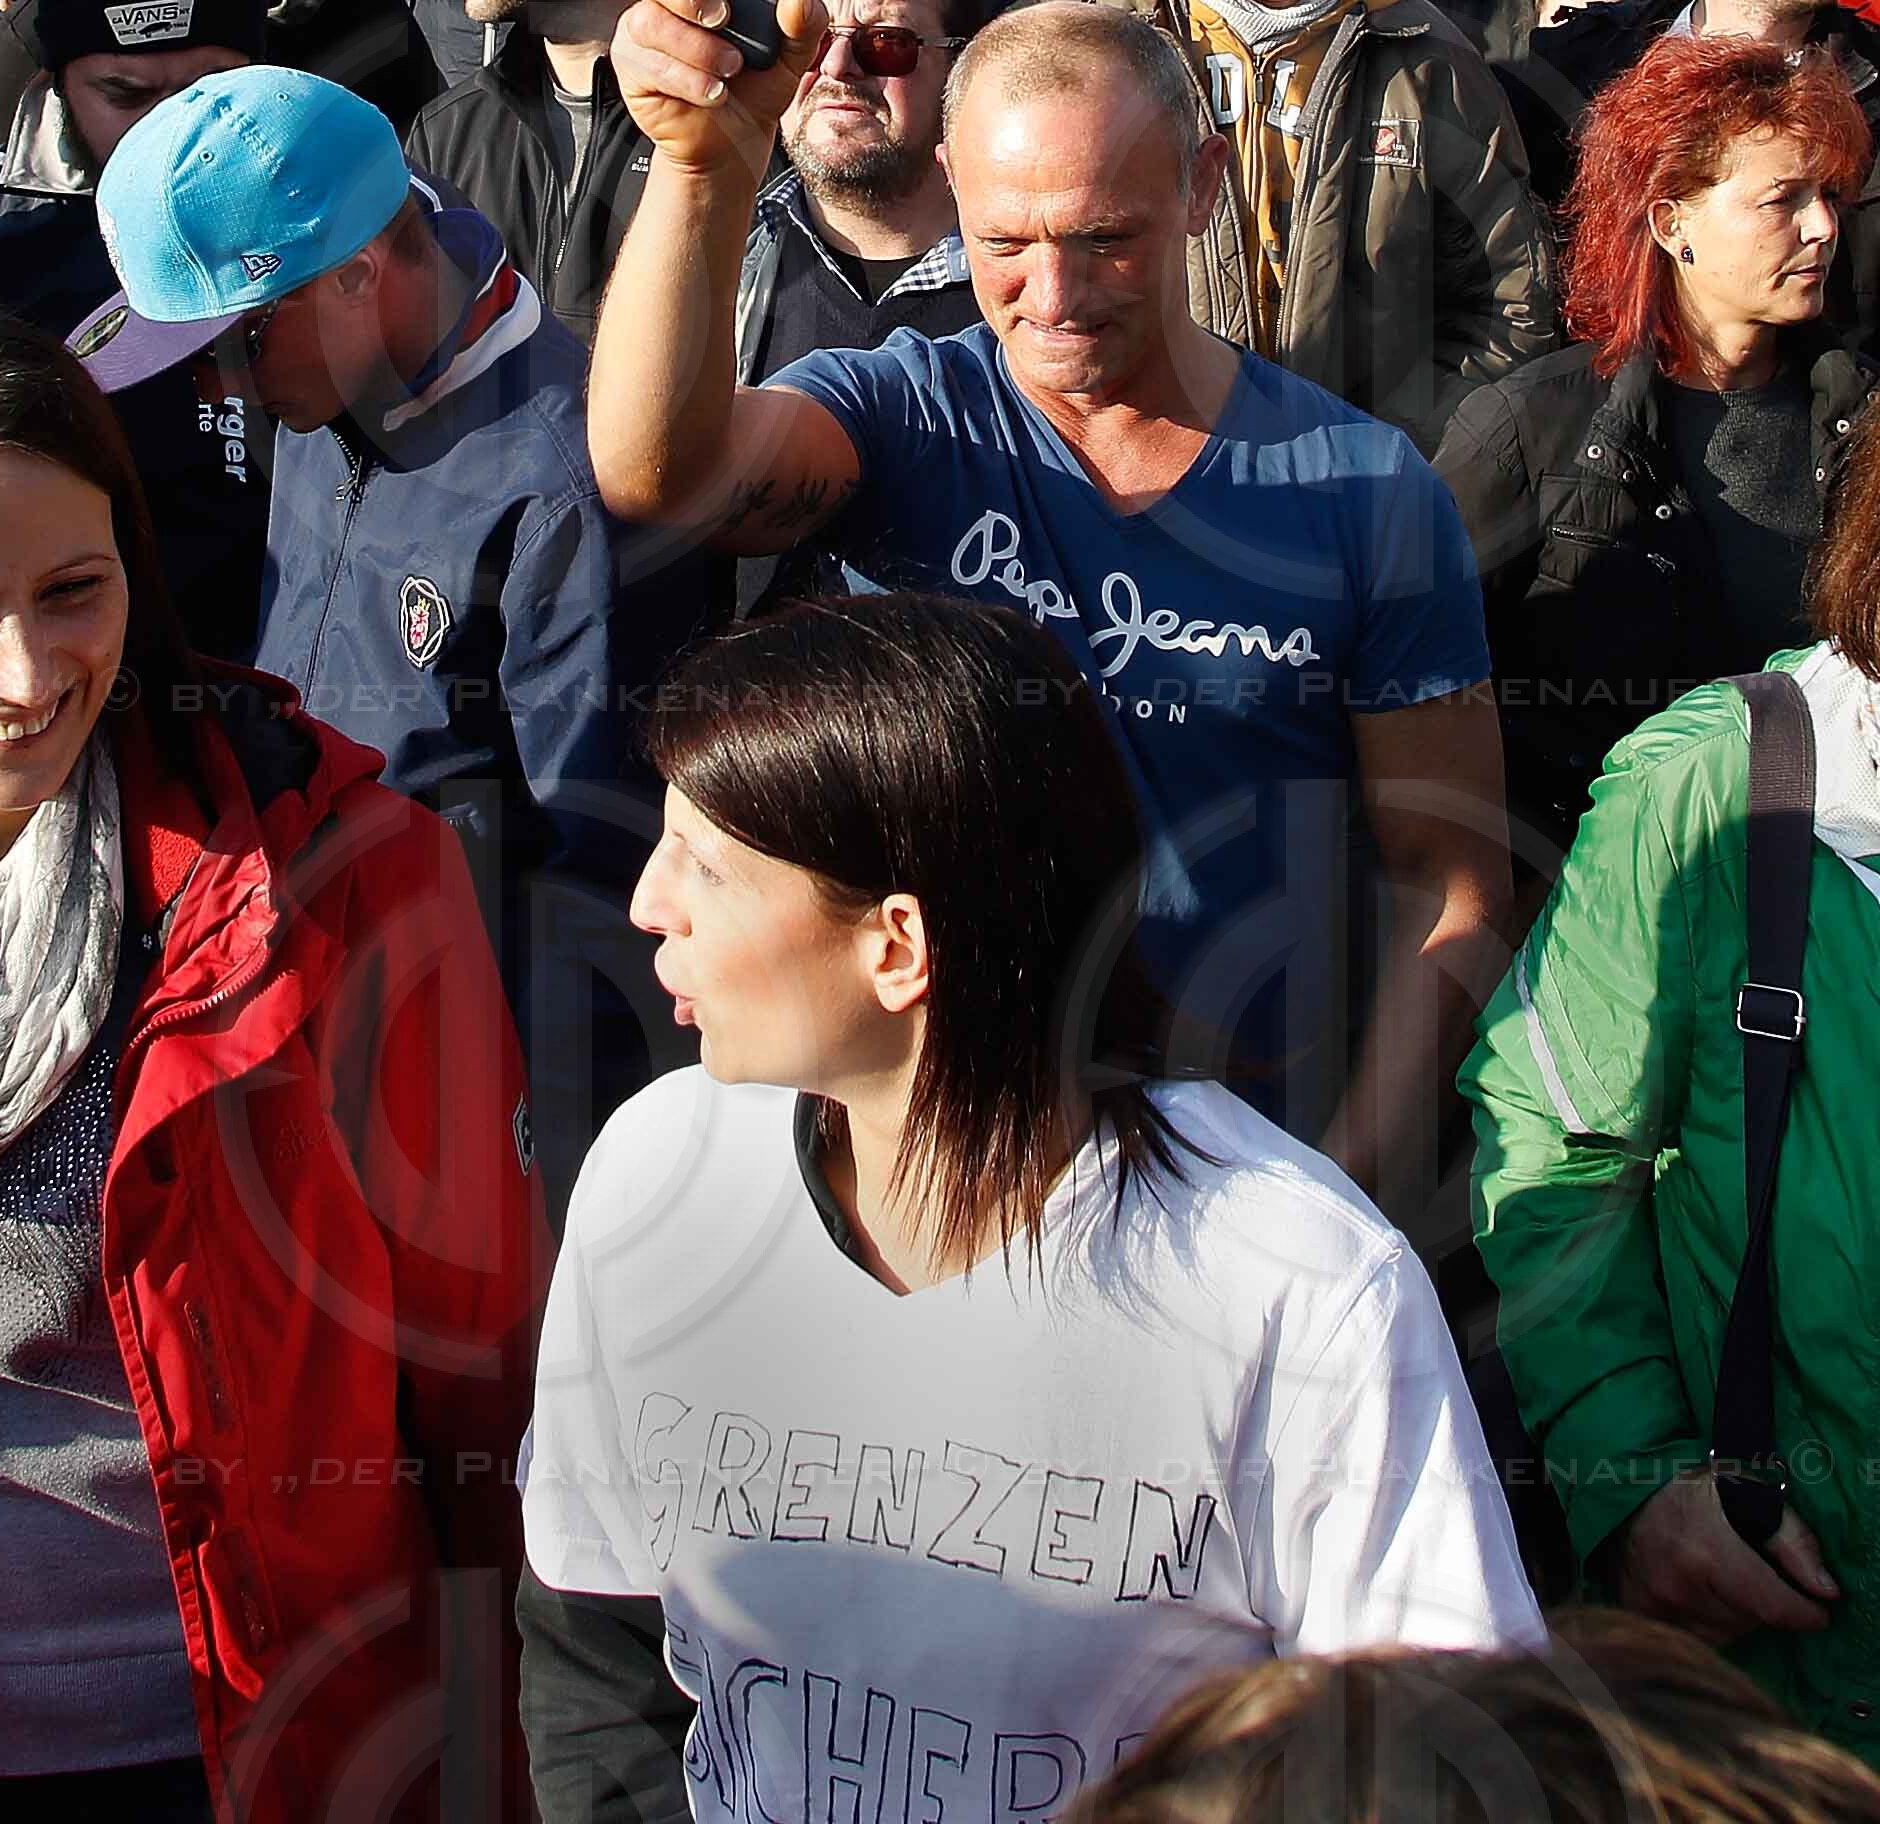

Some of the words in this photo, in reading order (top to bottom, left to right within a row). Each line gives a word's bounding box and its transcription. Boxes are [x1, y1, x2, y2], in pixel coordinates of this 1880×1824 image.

[121, 2, 180, 26] VANS
[197, 402, 216, 433] rte
[216, 395, 248, 484] rger
[1088, 571, 1321, 679] Jeans
[634, 1390, 1217, 1603] GRENZEN
